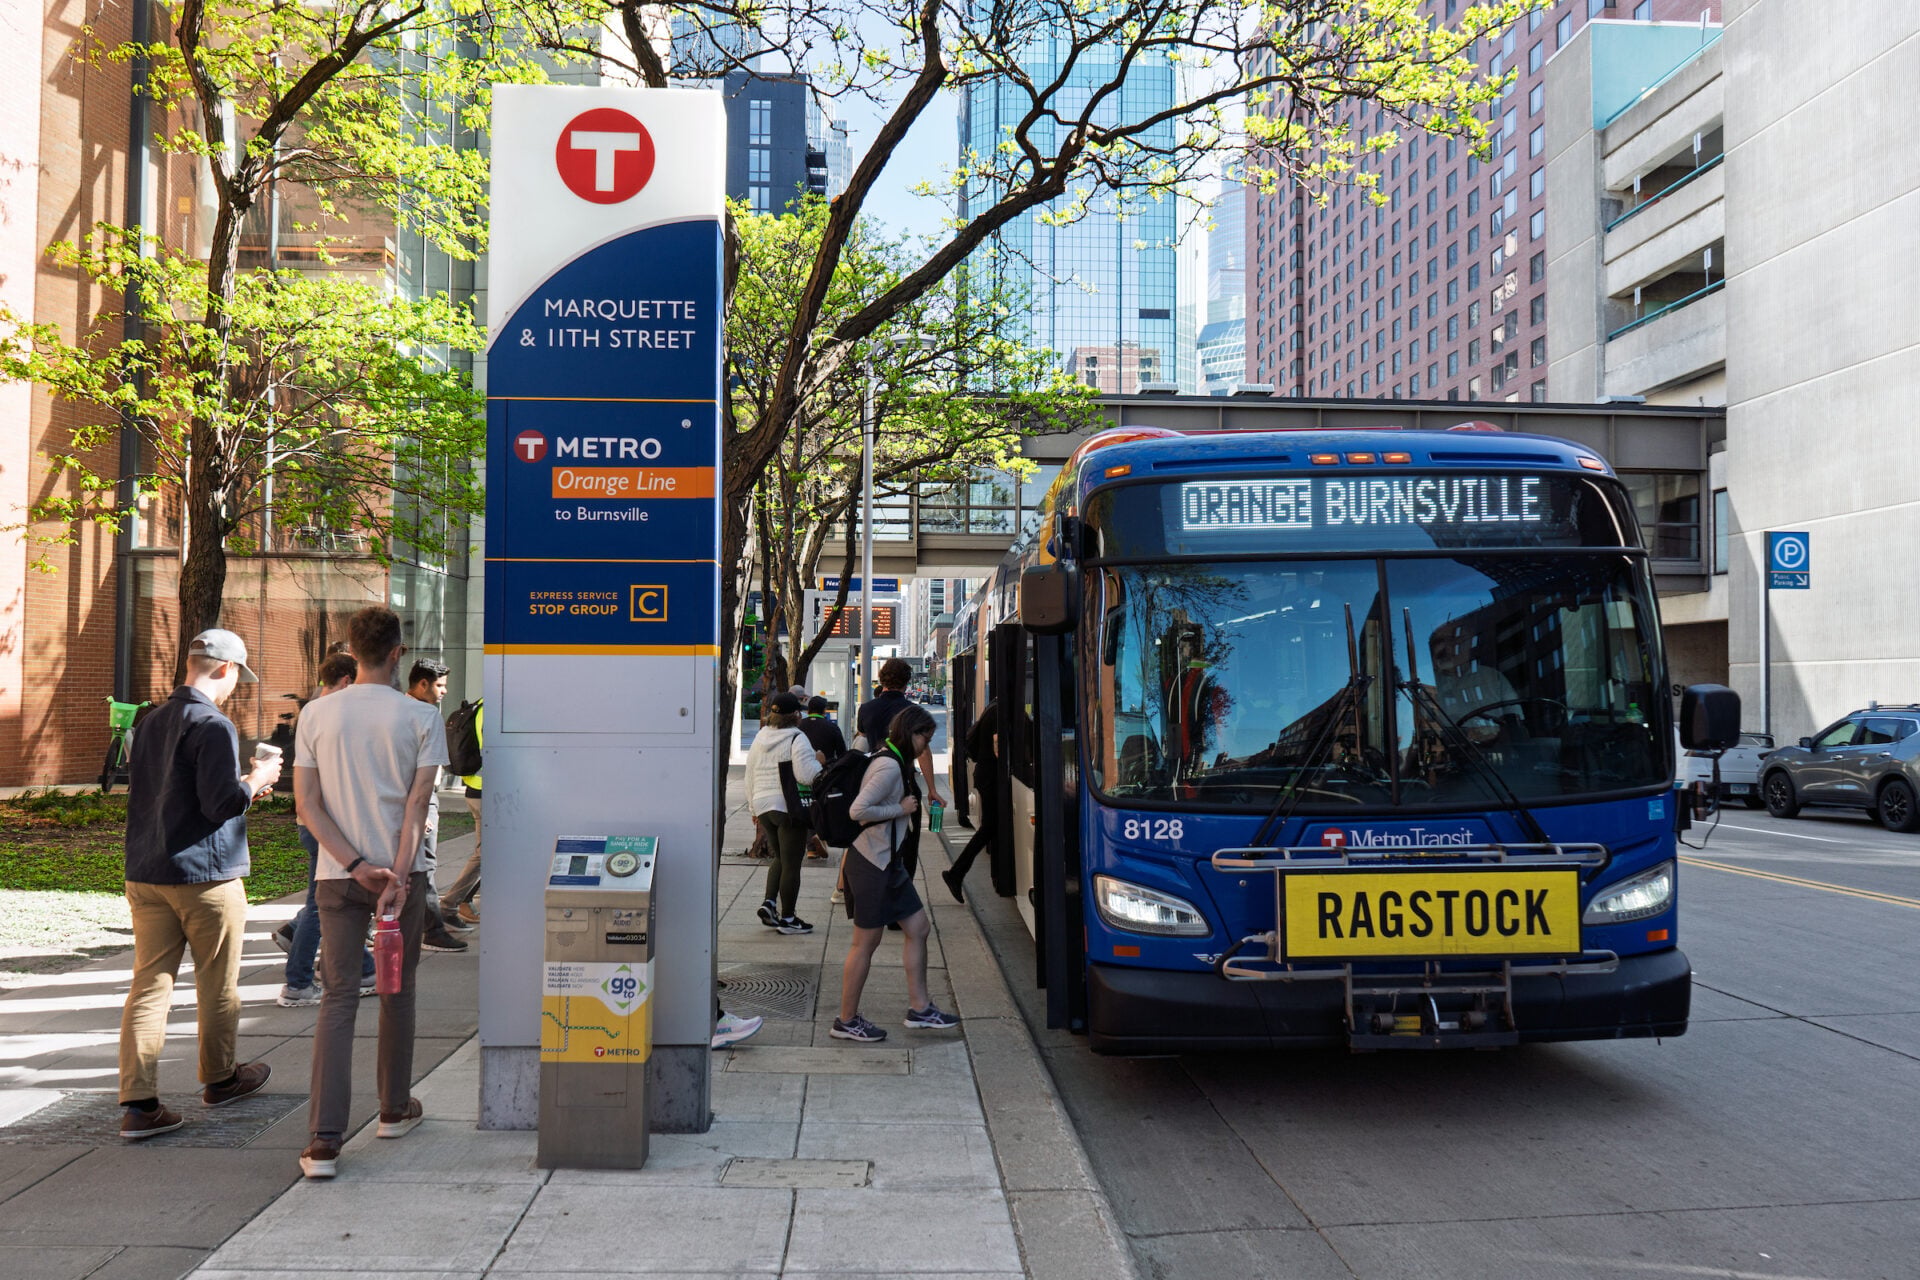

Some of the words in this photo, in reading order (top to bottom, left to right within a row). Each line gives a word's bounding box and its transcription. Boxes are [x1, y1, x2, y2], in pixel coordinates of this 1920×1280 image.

[571, 131, 640, 192] T
[545, 299, 696, 321] MARQUETTE
[519, 328, 536, 347] &
[549, 329, 600, 348] 11TH
[609, 330, 696, 349] STREET
[518, 437, 543, 459] T
[556, 437, 662, 459] METRO
[557, 470, 629, 496] Orange
[636, 471, 676, 491] Line
[1184, 483, 1312, 525] ORANGE
[1325, 478, 1541, 524] BURNSVILLE
[555, 508, 571, 521] to
[577, 507, 649, 521] Burnsville
[1784, 543, 1799, 562] P
[530, 591, 573, 600] EXPRESS
[577, 592, 618, 600] SERVICE
[638, 591, 659, 615] C
[529, 604, 565, 615] STOP
[569, 604, 619, 615] GROUP
[1124, 818, 1184, 840] 8128
[1318, 889, 1552, 938] RAGSTOCK
[611, 977, 636, 995] go
[623, 990, 635, 998] to
[607, 1048, 640, 1056] METRO
